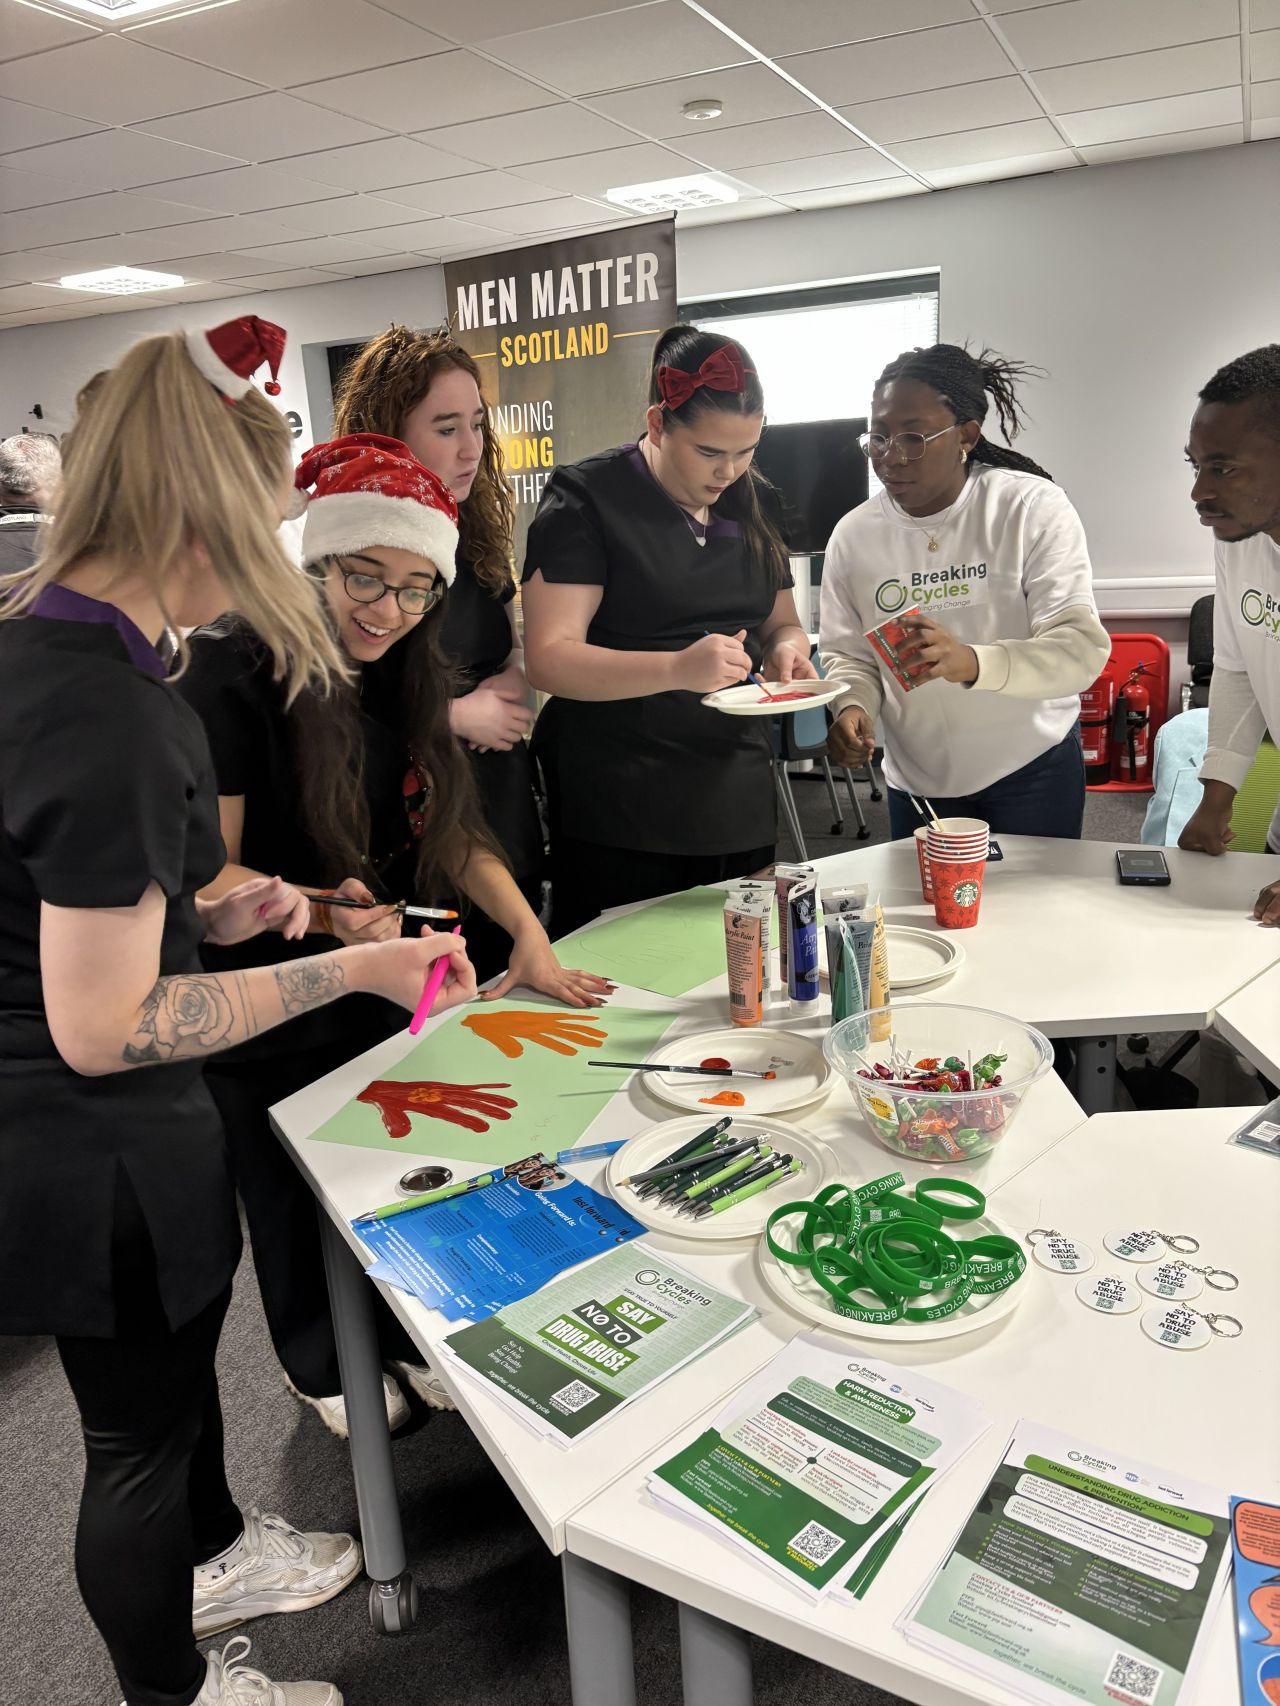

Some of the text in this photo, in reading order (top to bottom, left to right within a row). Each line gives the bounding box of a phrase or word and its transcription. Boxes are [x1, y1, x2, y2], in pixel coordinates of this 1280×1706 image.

[457, 252, 659, 331] MEN MATTER
[500, 322, 608, 368] SCOTLAND
[911, 562, 987, 587] Breaking
[911, 583, 969, 604] Cycles
[544, 1202, 573, 1221] Forward
[1127, 1236, 1149, 1248] DRUG
[1140, 1231, 1157, 1239] SAY
[1119, 1238, 1147, 1253] ABUSE
[1165, 1263, 1184, 1271] SAY
[1104, 1277, 1123, 1285] SAY
[1153, 1277, 1185, 1288] ABUSE
[1158, 1273, 1184, 1282] DRUG
[652, 1282, 694, 1306] Cycles
[660, 1277, 713, 1306] Breaking
[1092, 1290, 1124, 1302] ABUSE
[1098, 1286, 1122, 1296] DRUG
[613, 1300, 656, 1326] SAY
[926, 1295, 964, 1319] CYCLES
[1173, 1308, 1194, 1318] SAY
[845, 1308, 898, 1322] BREAKING
[1166, 1312, 1196, 1325] NO TO
[576, 1304, 636, 1345] NO TO
[1158, 1322, 1192, 1336] ABUSE
[1165, 1318, 1191, 1330] DRUG
[542, 1318, 632, 1373] DRUG ABUSE
[843, 1380, 868, 1395] HARM
[867, 1392, 914, 1417] REDUCTION
[852, 1393, 901, 1419] AWARENESS
[1081, 1458, 1107, 1470] Cycles
[1083, 1454, 1116, 1470] Breaking
[1047, 1464, 1116, 1493] UNDERSTANDING
[1117, 1490, 1141, 1502] DRUG
[1141, 1499, 1189, 1520] ADDICTION
